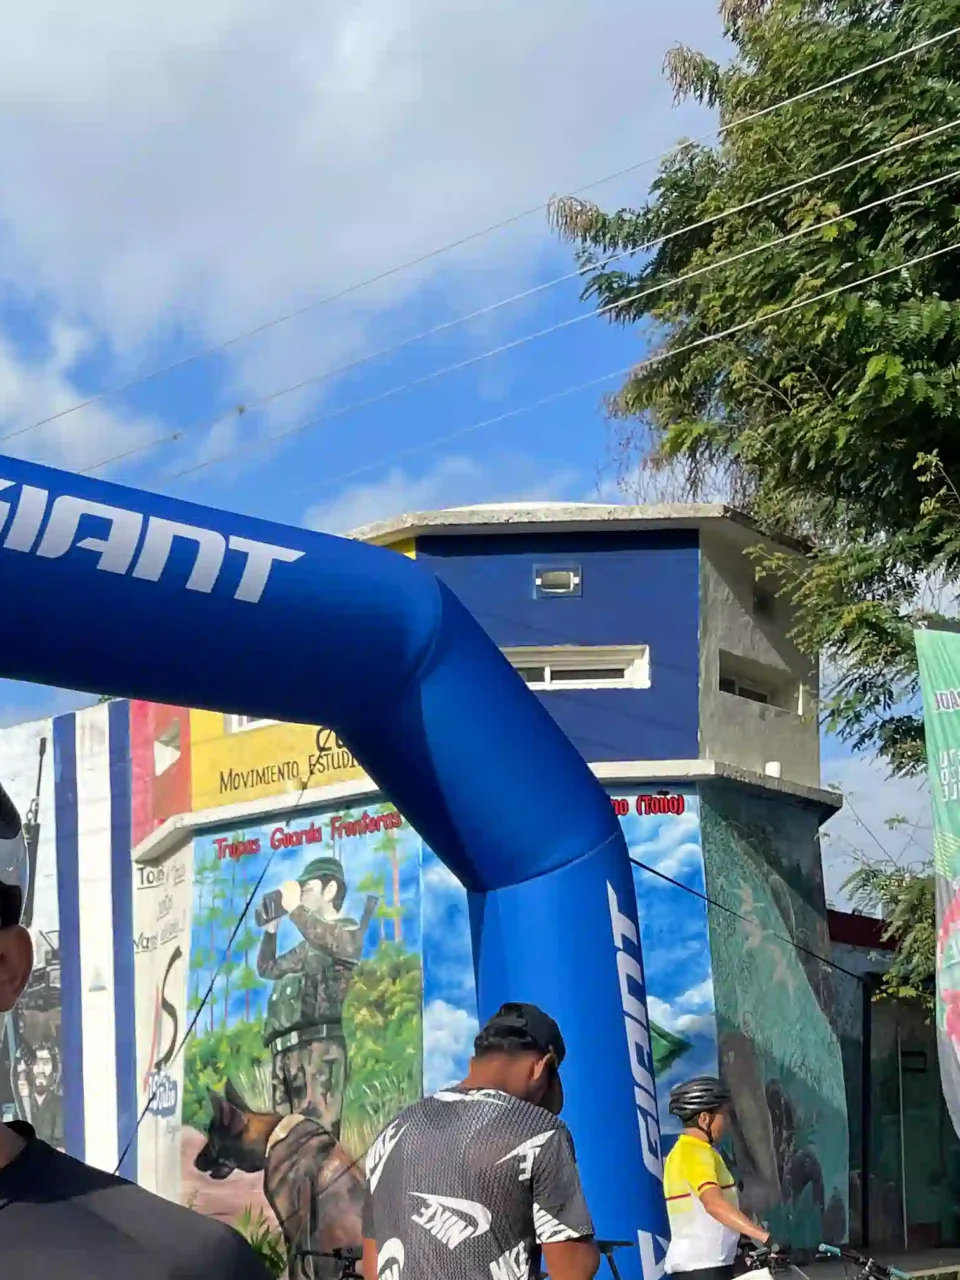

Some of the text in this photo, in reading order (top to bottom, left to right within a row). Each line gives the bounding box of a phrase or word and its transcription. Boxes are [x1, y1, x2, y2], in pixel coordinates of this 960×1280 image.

[219, 750, 361, 794] MOVIMIENTO ESTUDI
[269, 820, 323, 851] Guarda
[606, 879, 664, 1184] GIANT
[410, 1203, 475, 1250] NIKE
